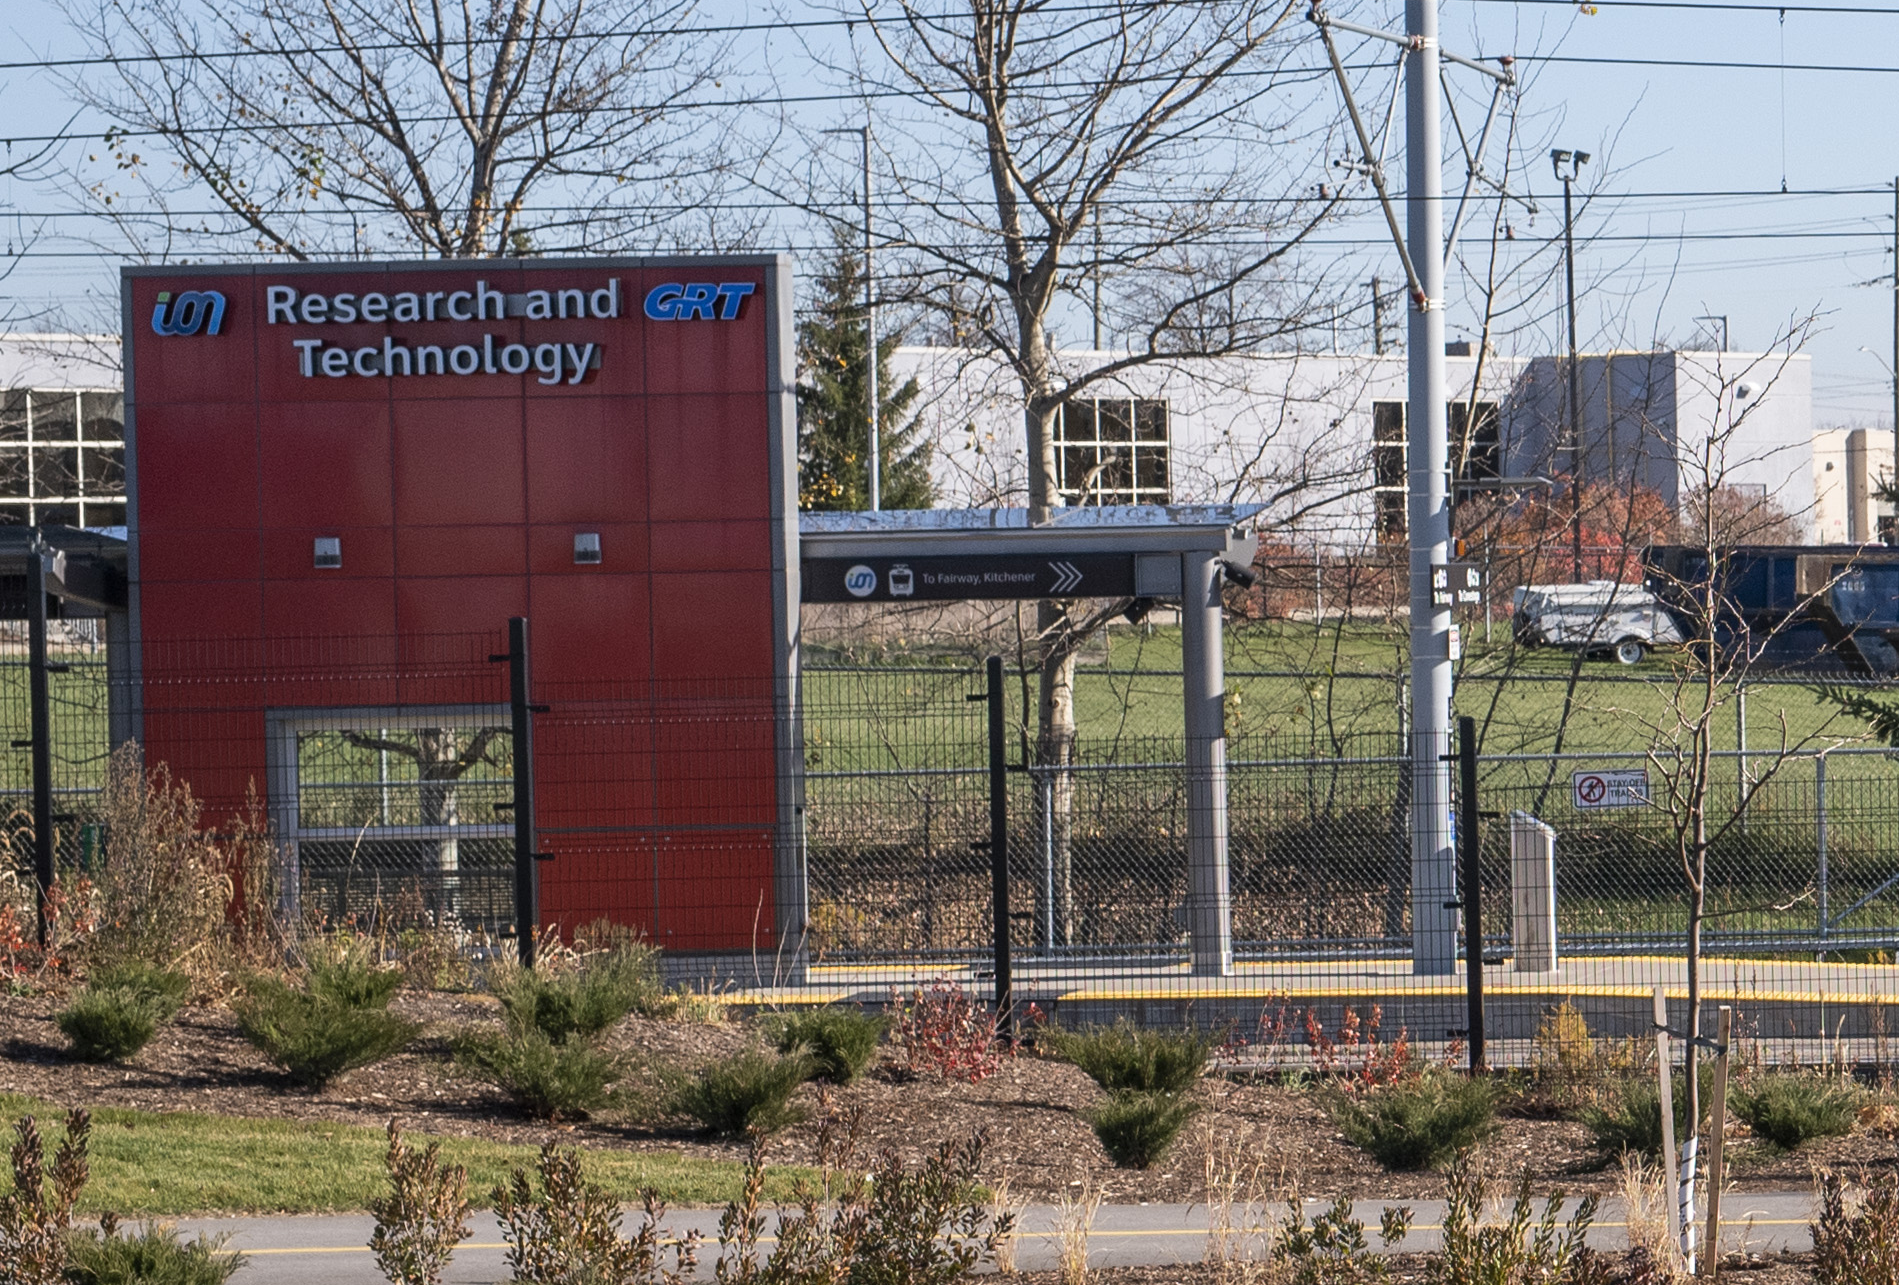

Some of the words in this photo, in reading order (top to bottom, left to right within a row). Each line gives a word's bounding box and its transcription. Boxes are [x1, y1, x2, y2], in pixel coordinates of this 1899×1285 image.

[266, 280, 505, 324] Research
[525, 277, 619, 318] and
[643, 282, 756, 321] GRT
[292, 333, 594, 385] Technology
[922, 573, 935, 584] To
[937, 572, 982, 586] Fairway,
[983, 571, 1036, 583] Kitchener
